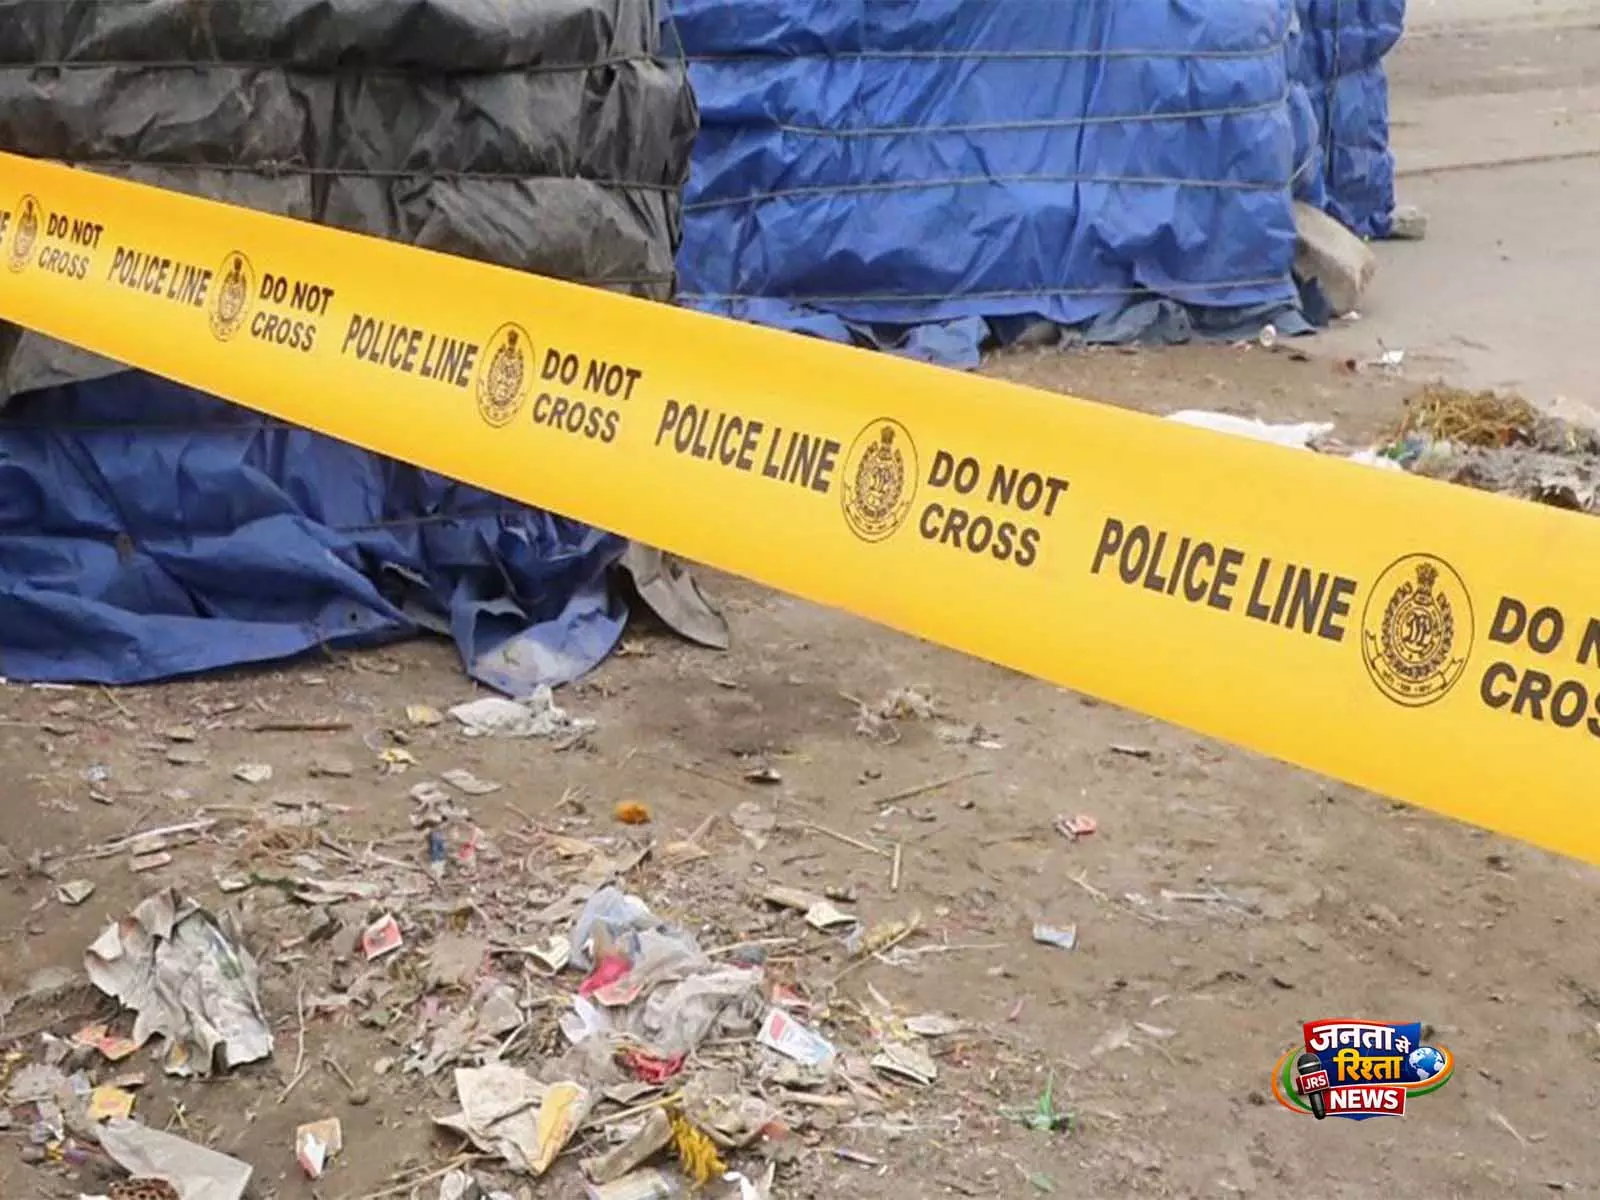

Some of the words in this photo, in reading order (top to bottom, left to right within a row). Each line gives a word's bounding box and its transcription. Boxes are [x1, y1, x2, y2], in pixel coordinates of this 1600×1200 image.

[47, 213, 68, 239] DO
[71, 219, 104, 248] NOT
[39, 247, 89, 280] CROSS
[107, 246, 170, 294] POLICE
[167, 263, 212, 306] LINE
[259, 273, 288, 304] DO
[290, 281, 334, 315] NOT
[251, 312, 316, 352] CROSS
[342, 314, 423, 372] POLICE
[420, 334, 479, 387] LINE
[541, 348, 579, 385] DO
[583, 359, 642, 400] NOT
[533, 393, 619, 443] CROSS
[655, 400, 764, 471] POLICE
[762, 428, 840, 493] LINE
[928, 450, 980, 494] DO
[987, 464, 1069, 516] NOT
[919, 503, 1040, 567] CROSS
[1091, 518, 1245, 611] POLICE
[1245, 558, 1357, 642] LINE
[1488, 596, 1564, 654] DO
